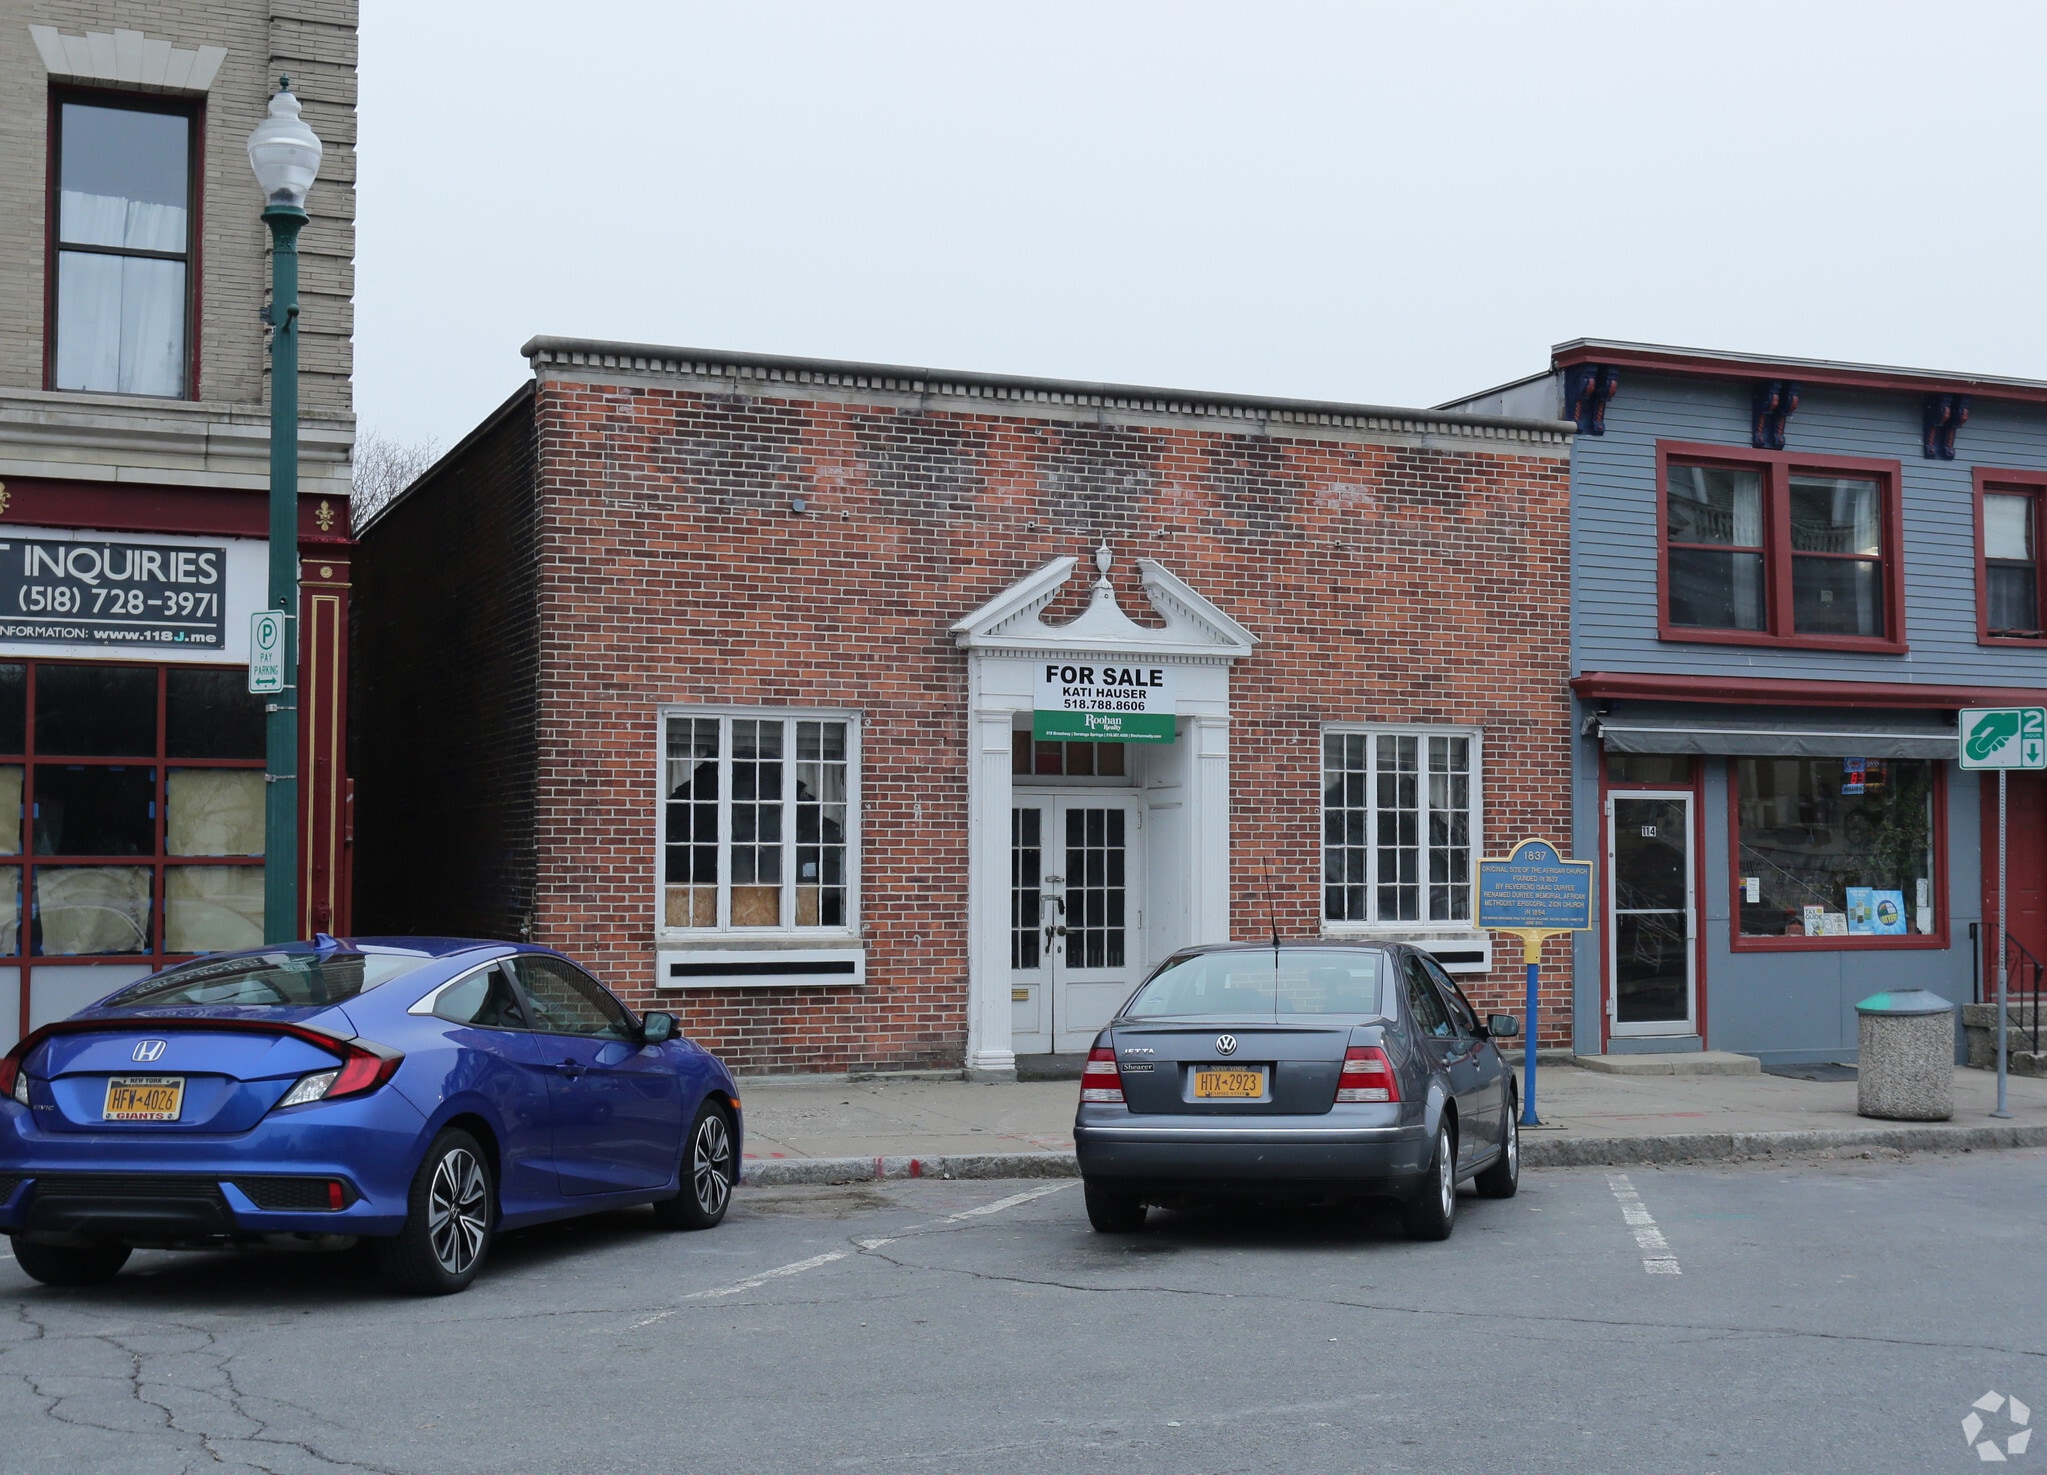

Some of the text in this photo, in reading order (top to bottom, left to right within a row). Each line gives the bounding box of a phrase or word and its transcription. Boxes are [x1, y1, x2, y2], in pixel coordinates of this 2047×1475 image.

[24, 545, 218, 585] INQUIRIES
[19, 585, 217, 616] (518) 728-3971
[93, 630, 217, 643] www.118J.me
[263, 624, 273, 644] P
[260, 653, 272, 662] PAY
[254, 665, 278, 675] PARKING
[1046, 665, 1163, 687] FOR SALE
[1063, 687, 1147, 699] KATI HAUSER
[1064, 699, 1145, 711] 518.788.8606
[1085, 713, 1122, 730] Roohan
[2024, 711, 2043, 732] 2
[1642, 827, 1655, 836] 114
[1524, 851, 1547, 861] 1837
[1123, 1063, 1154, 1071] Shearer
[1201, 1073, 1257, 1091] HTX 2923
[112, 1088, 174, 1110] HFW 4026
[116, 1112, 165, 1120] GIANTS
